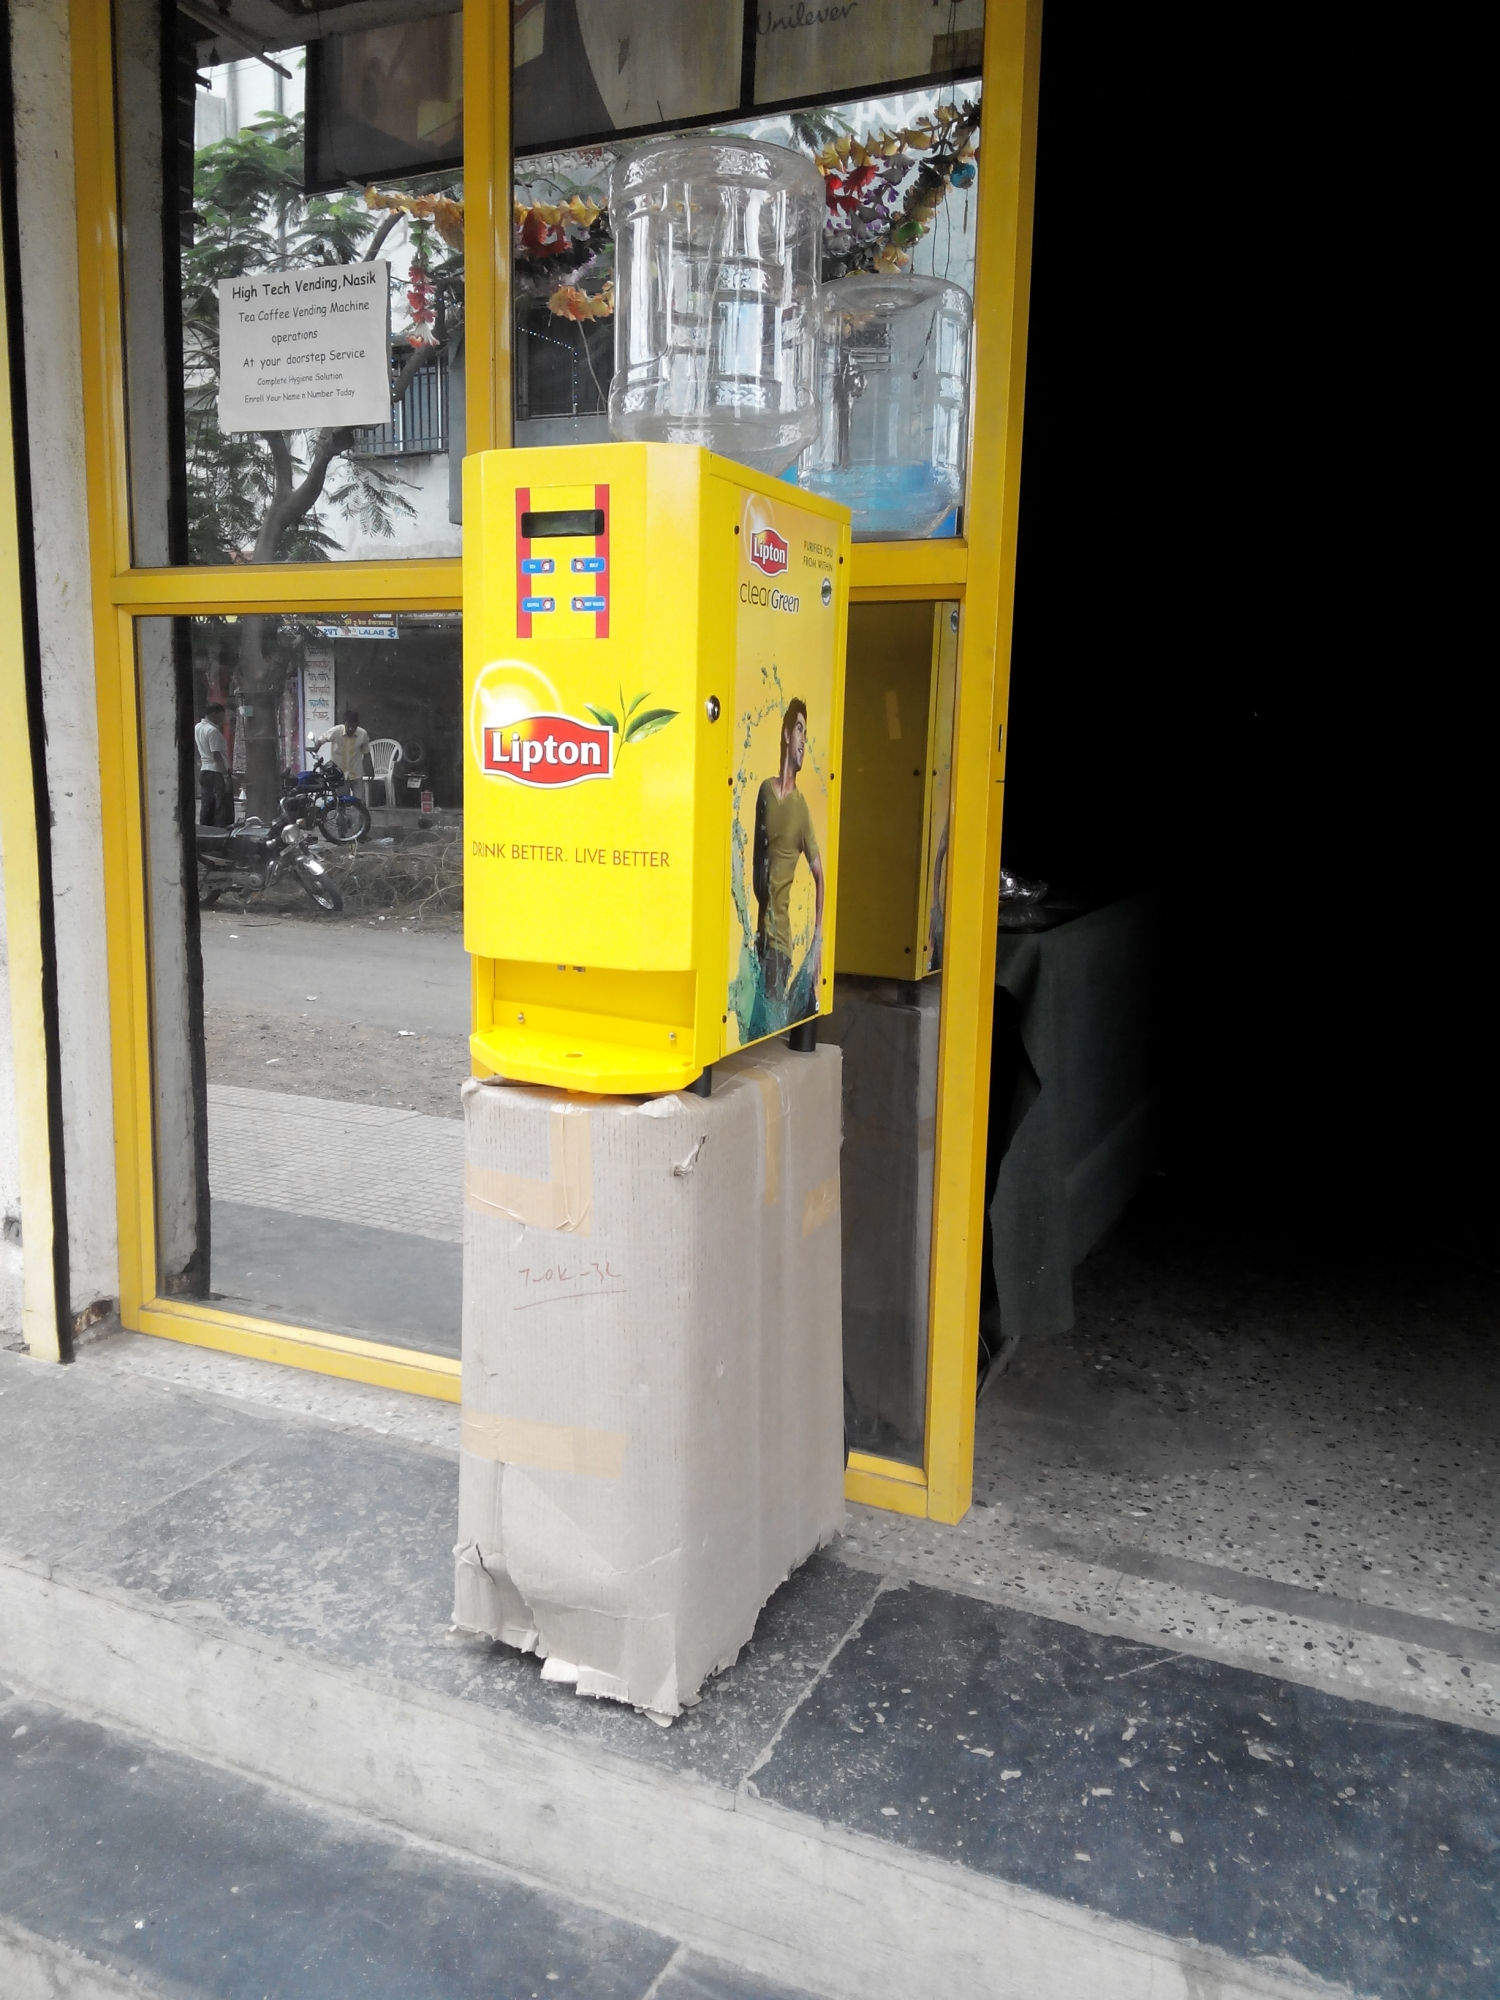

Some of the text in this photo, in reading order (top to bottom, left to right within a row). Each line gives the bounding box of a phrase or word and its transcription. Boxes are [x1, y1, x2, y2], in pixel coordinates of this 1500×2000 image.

[757, 2, 858, 35] Unilever
[232, 285, 258, 301] High
[262, 281, 290, 296] Tech
[238, 300, 370, 323] Tea Coffee Vending Machine
[271, 329, 318, 345] operations
[242, 348, 365, 370] At your doorstep Service
[257, 375, 287, 386] Complete
[315, 372, 343, 381] Solution
[244, 394, 264, 403] Enroll
[266, 393, 281, 402] Your
[307, 390, 334, 398] Number
[336, 388, 355, 397] Today
[754, 537, 785, 564] Lipton
[491, 731, 602, 772] Lipton
[472, 840, 671, 868] DRINK BETTER. LIVE BETTER
